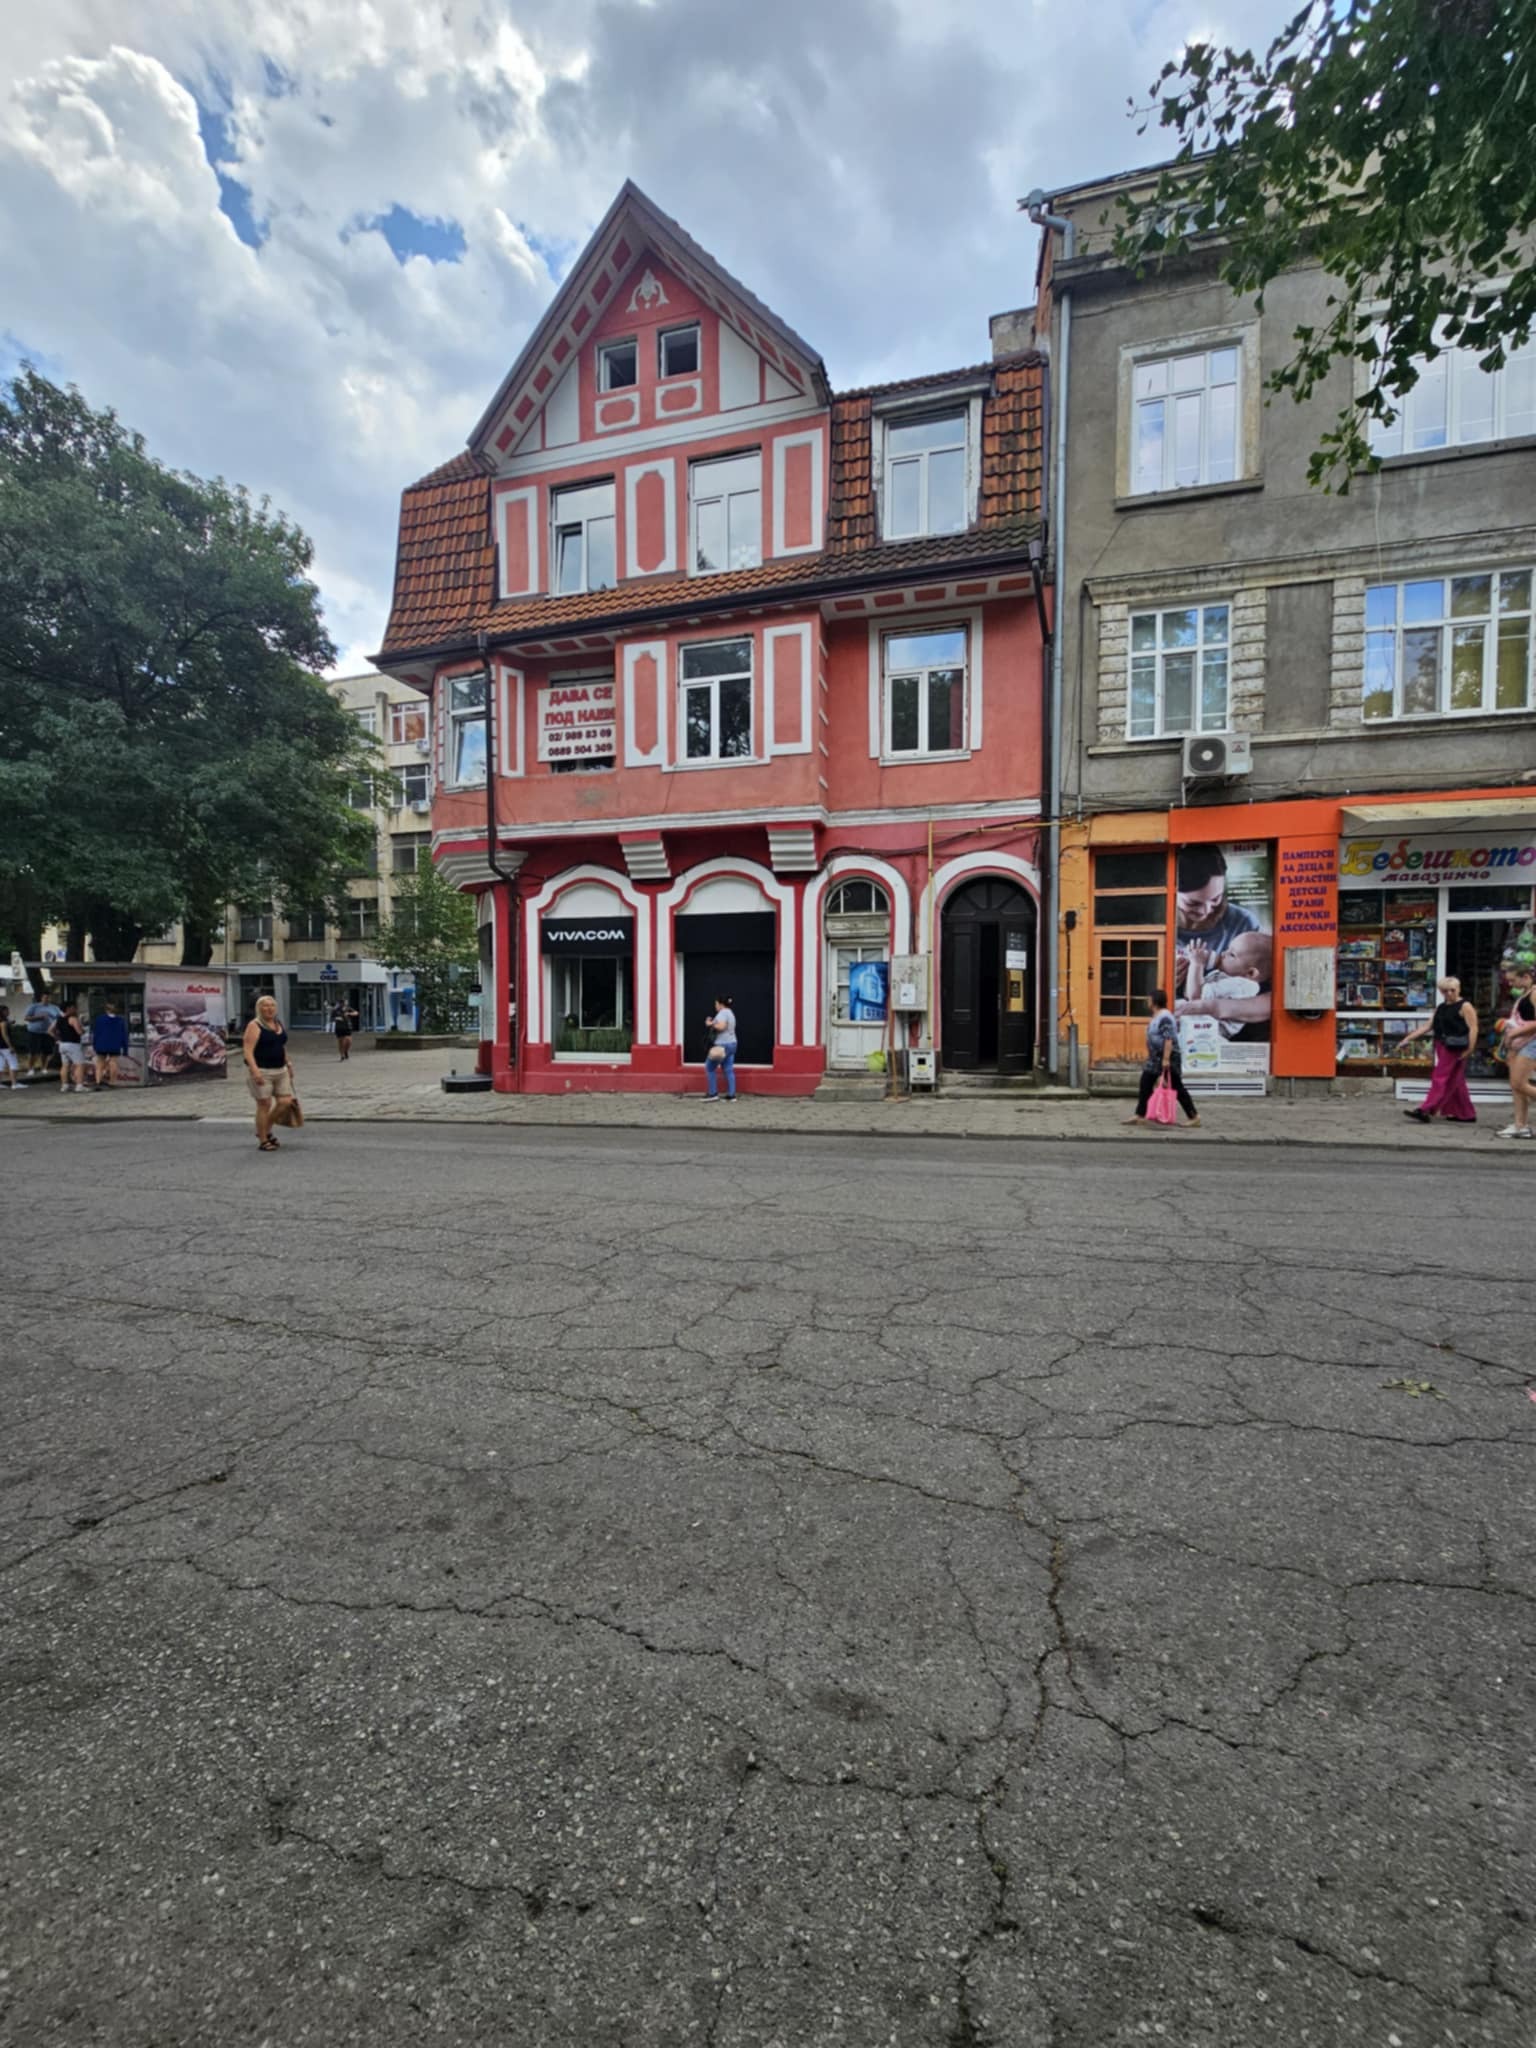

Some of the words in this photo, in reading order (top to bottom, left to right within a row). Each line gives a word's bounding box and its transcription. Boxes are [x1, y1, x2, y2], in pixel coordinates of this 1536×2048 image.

[549, 689, 589, 706] ДАВА
[593, 686, 613, 700] СЕ
[545, 710, 575, 727] ПОД
[1340, 839, 1536, 877] Бебешкото
[1298, 863, 1324, 873] ДЕЦА
[1289, 886, 1327, 897] ДЕТСКИ
[1292, 898, 1324, 908] ХРАНИ
[1285, 910, 1330, 920] ИГРАЧКИ
[1280, 922, 1336, 932] АКСЕСОАРИ
[547, 930, 625, 941] VIVACOM
